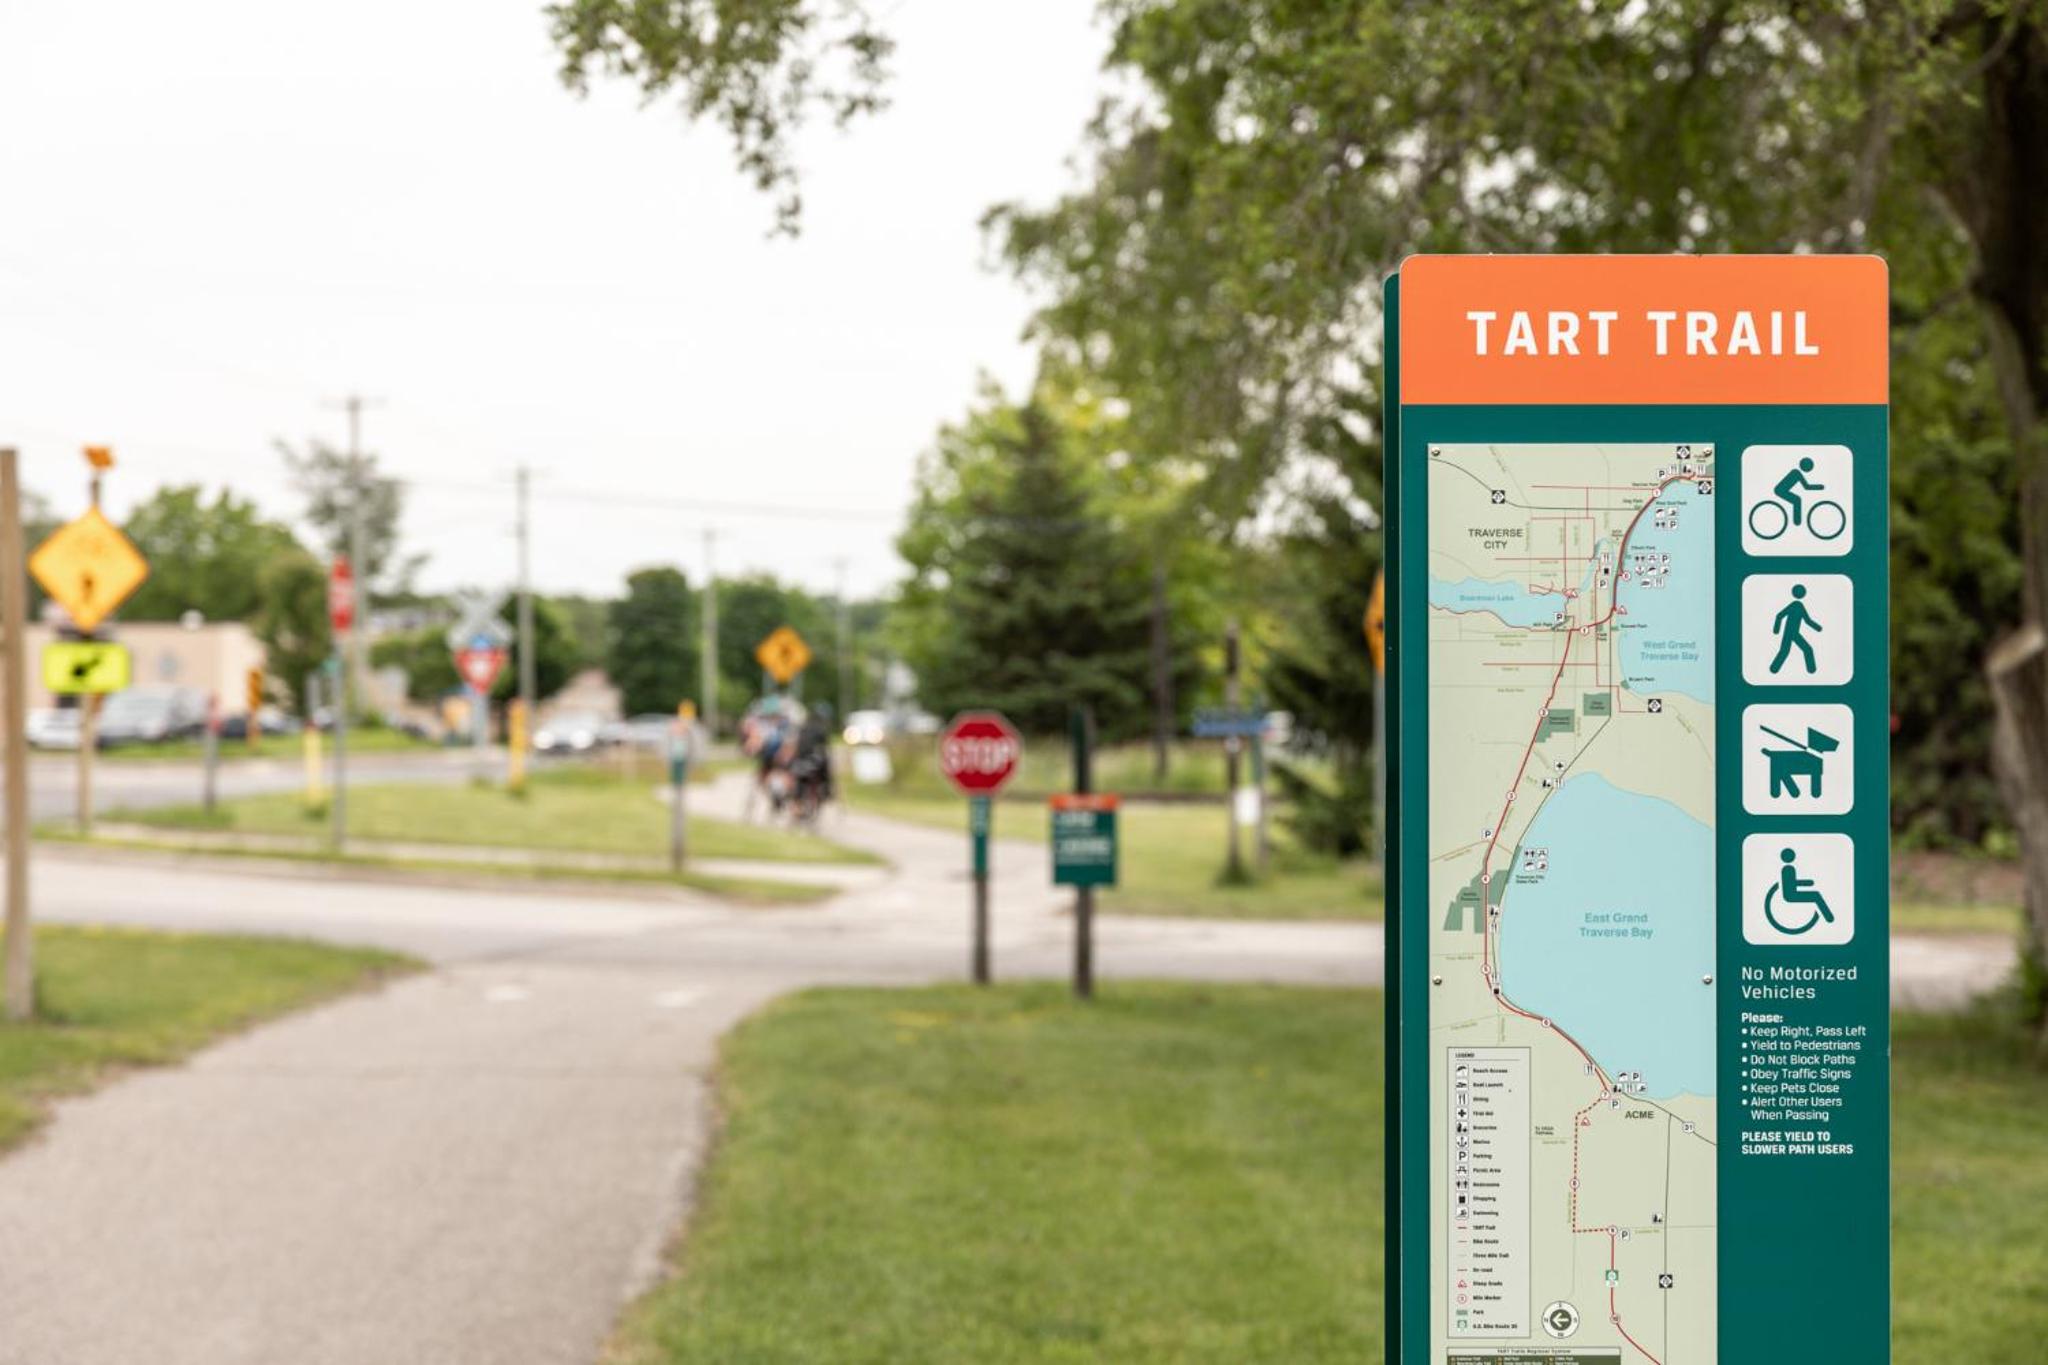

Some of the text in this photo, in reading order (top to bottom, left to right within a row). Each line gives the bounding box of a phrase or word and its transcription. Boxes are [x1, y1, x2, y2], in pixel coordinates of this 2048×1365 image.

[1466, 310, 1819, 356] TART TRAIL
[1468, 528, 1523, 538] TRAVERSE
[1484, 541, 1508, 550] CITY
[1643, 641, 1696, 649] West Grand
[1641, 652, 1698, 662] Traverse Bay
[944, 737, 1018, 775] STOP
[1584, 912, 1648, 923] East Grand
[1580, 928, 1654, 939] Traverse Bay
[1742, 966, 1858, 980] No Motorized
[1742, 985, 1816, 999] Vehicles
[1742, 1012, 1784, 1023] Please:
[1750, 1025, 1866, 1038] Keep Right, Pass Left
[1750, 1040, 1861, 1050] Yield to Pedestrians
[1750, 1054, 1856, 1065] Do Not Block Paths
[1750, 1068, 1852, 1082] Obey Traffic Signs
[1750, 1082, 1840, 1095] Keep Pets Close
[1750, 1096, 1842, 1106] Alert Other Users
[1625, 1111, 1654, 1119] ACME
[1751, 1110, 1829, 1122] When Passing
[1742, 1131, 1831, 1142] PLEASE YIELD TO
[1742, 1144, 1854, 1155] SLOWER PATH USERS
[1459, 1151, 1466, 1160] P
